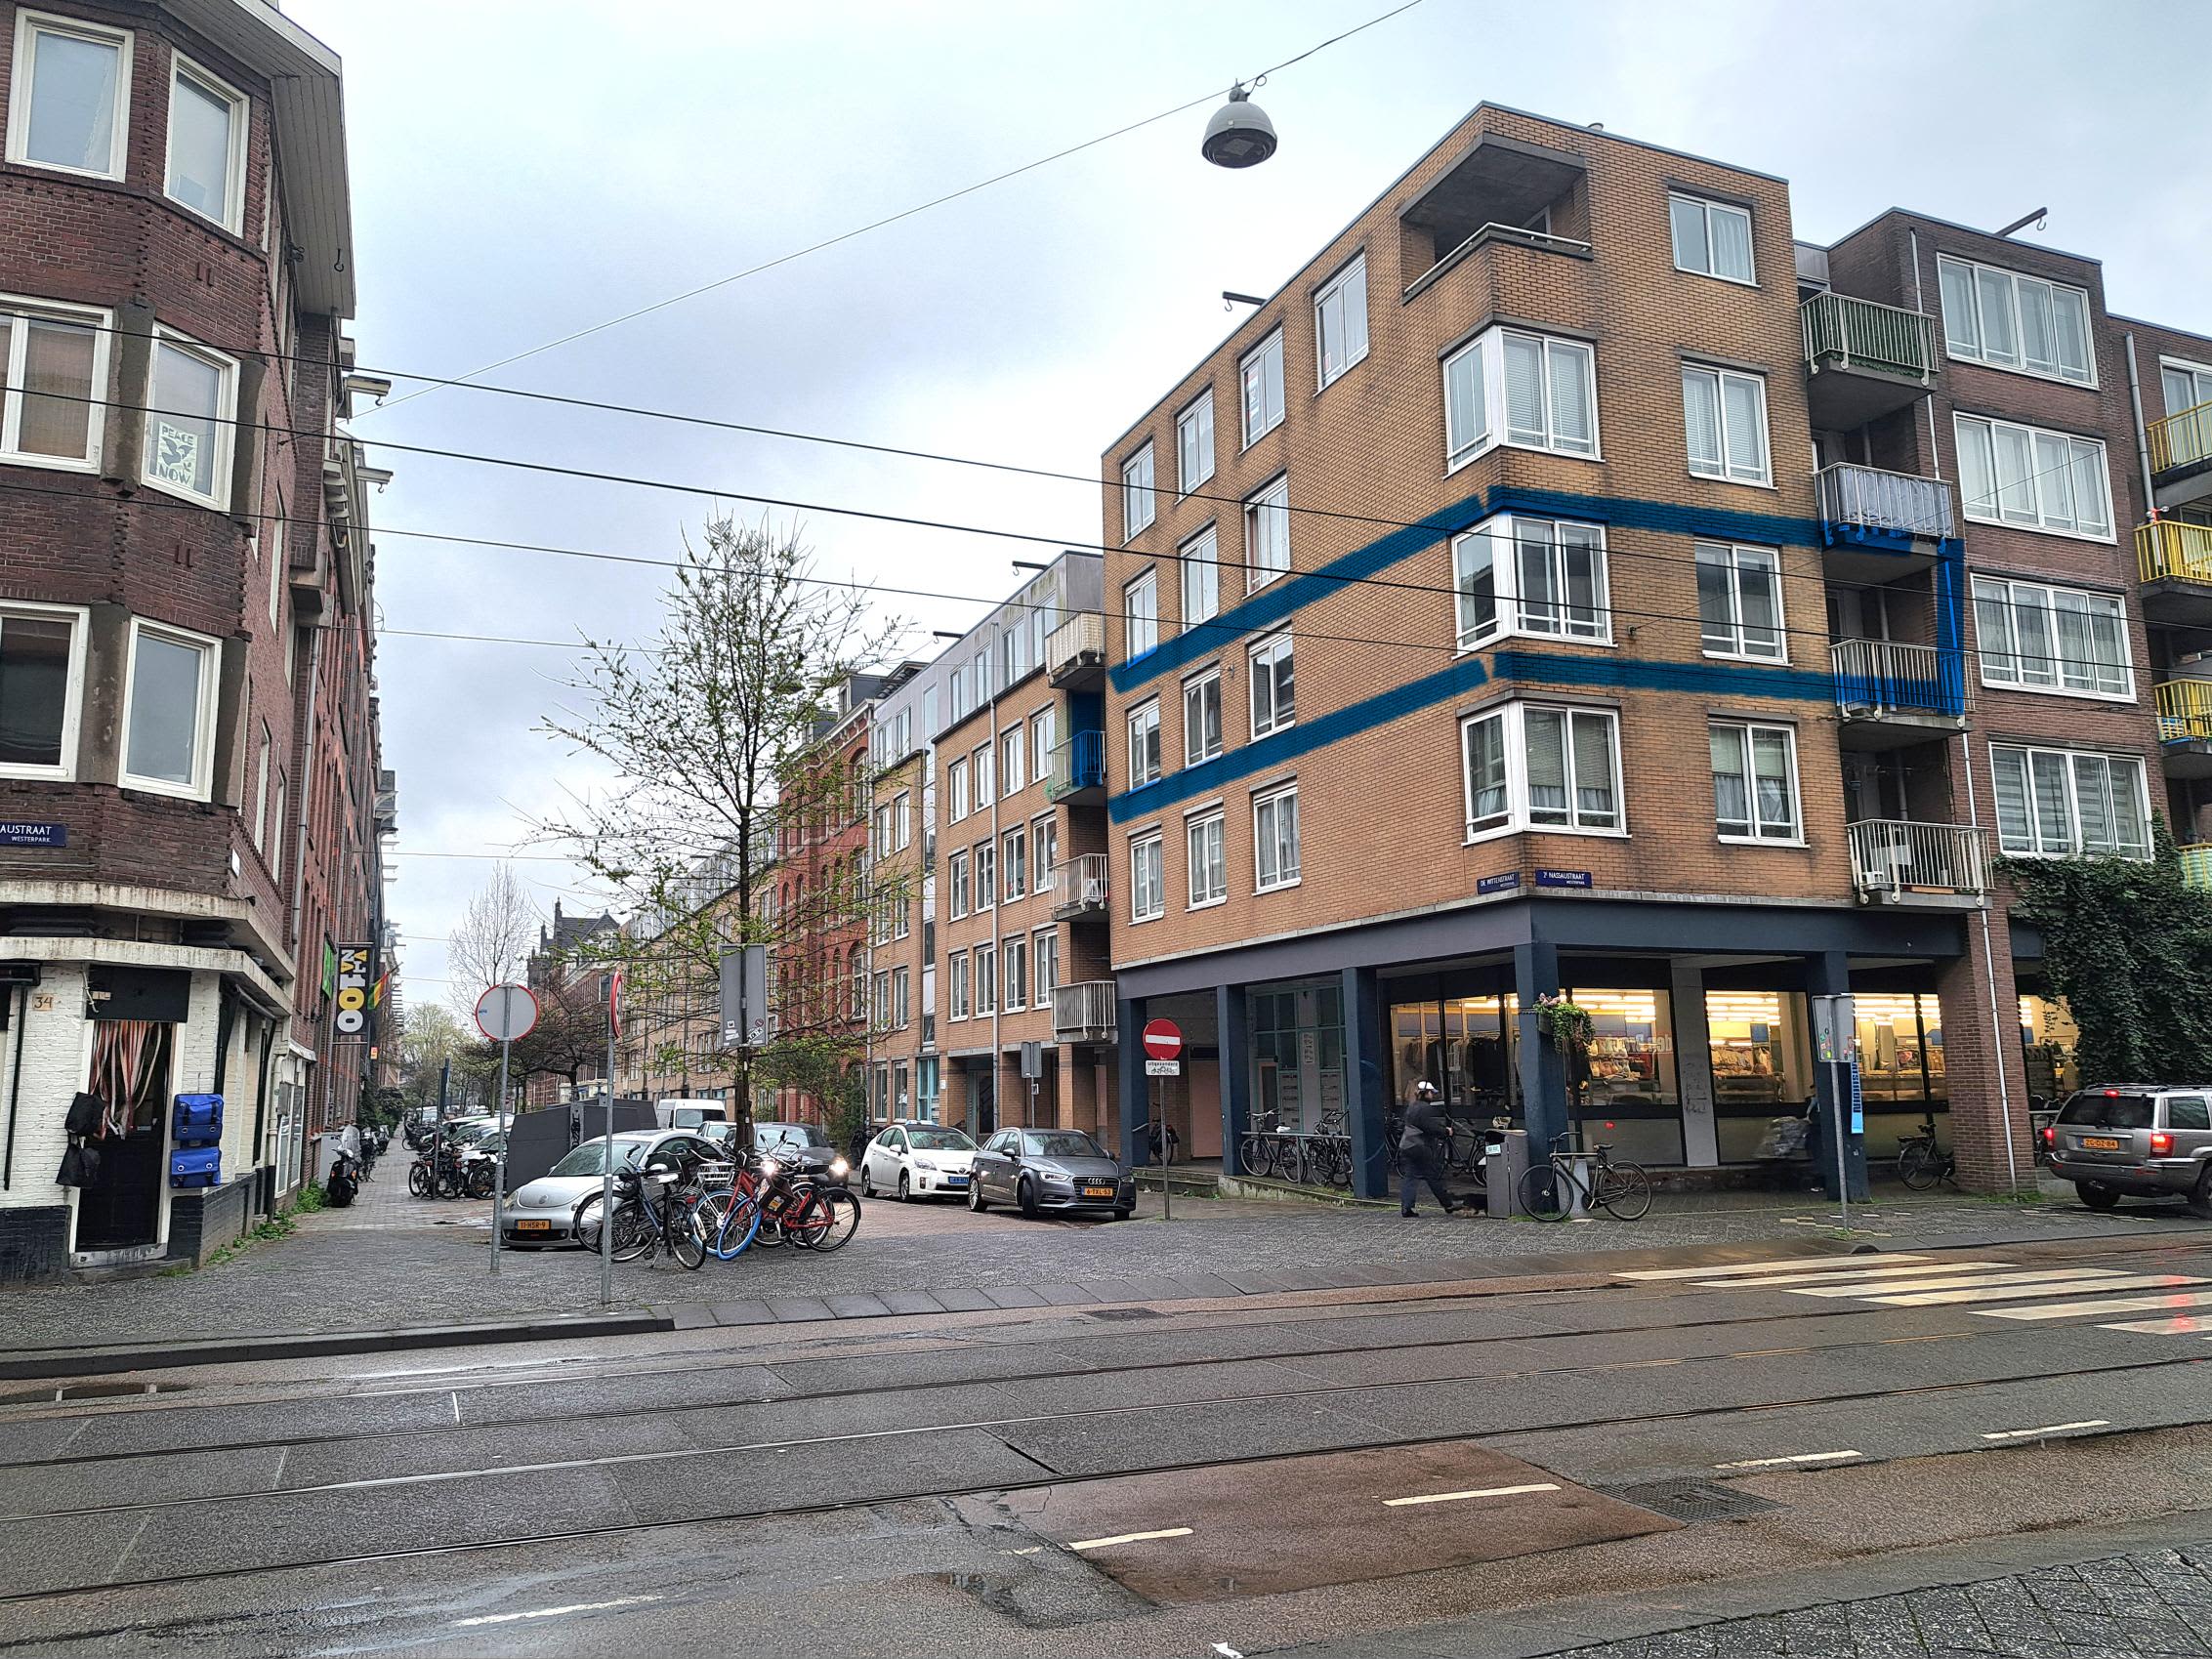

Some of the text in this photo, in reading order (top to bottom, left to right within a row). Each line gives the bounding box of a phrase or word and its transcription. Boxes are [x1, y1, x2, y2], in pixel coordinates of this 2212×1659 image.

[162, 426, 194, 446] PEACE
[159, 464, 191, 485] NOW
[0, 824, 53, 835] AUSTRAAT
[1486, 873, 1515, 886] WITTENSTRAAT
[1548, 871, 1585, 880] NASSAUSTRAAT
[34, 996, 53, 1009] 34
